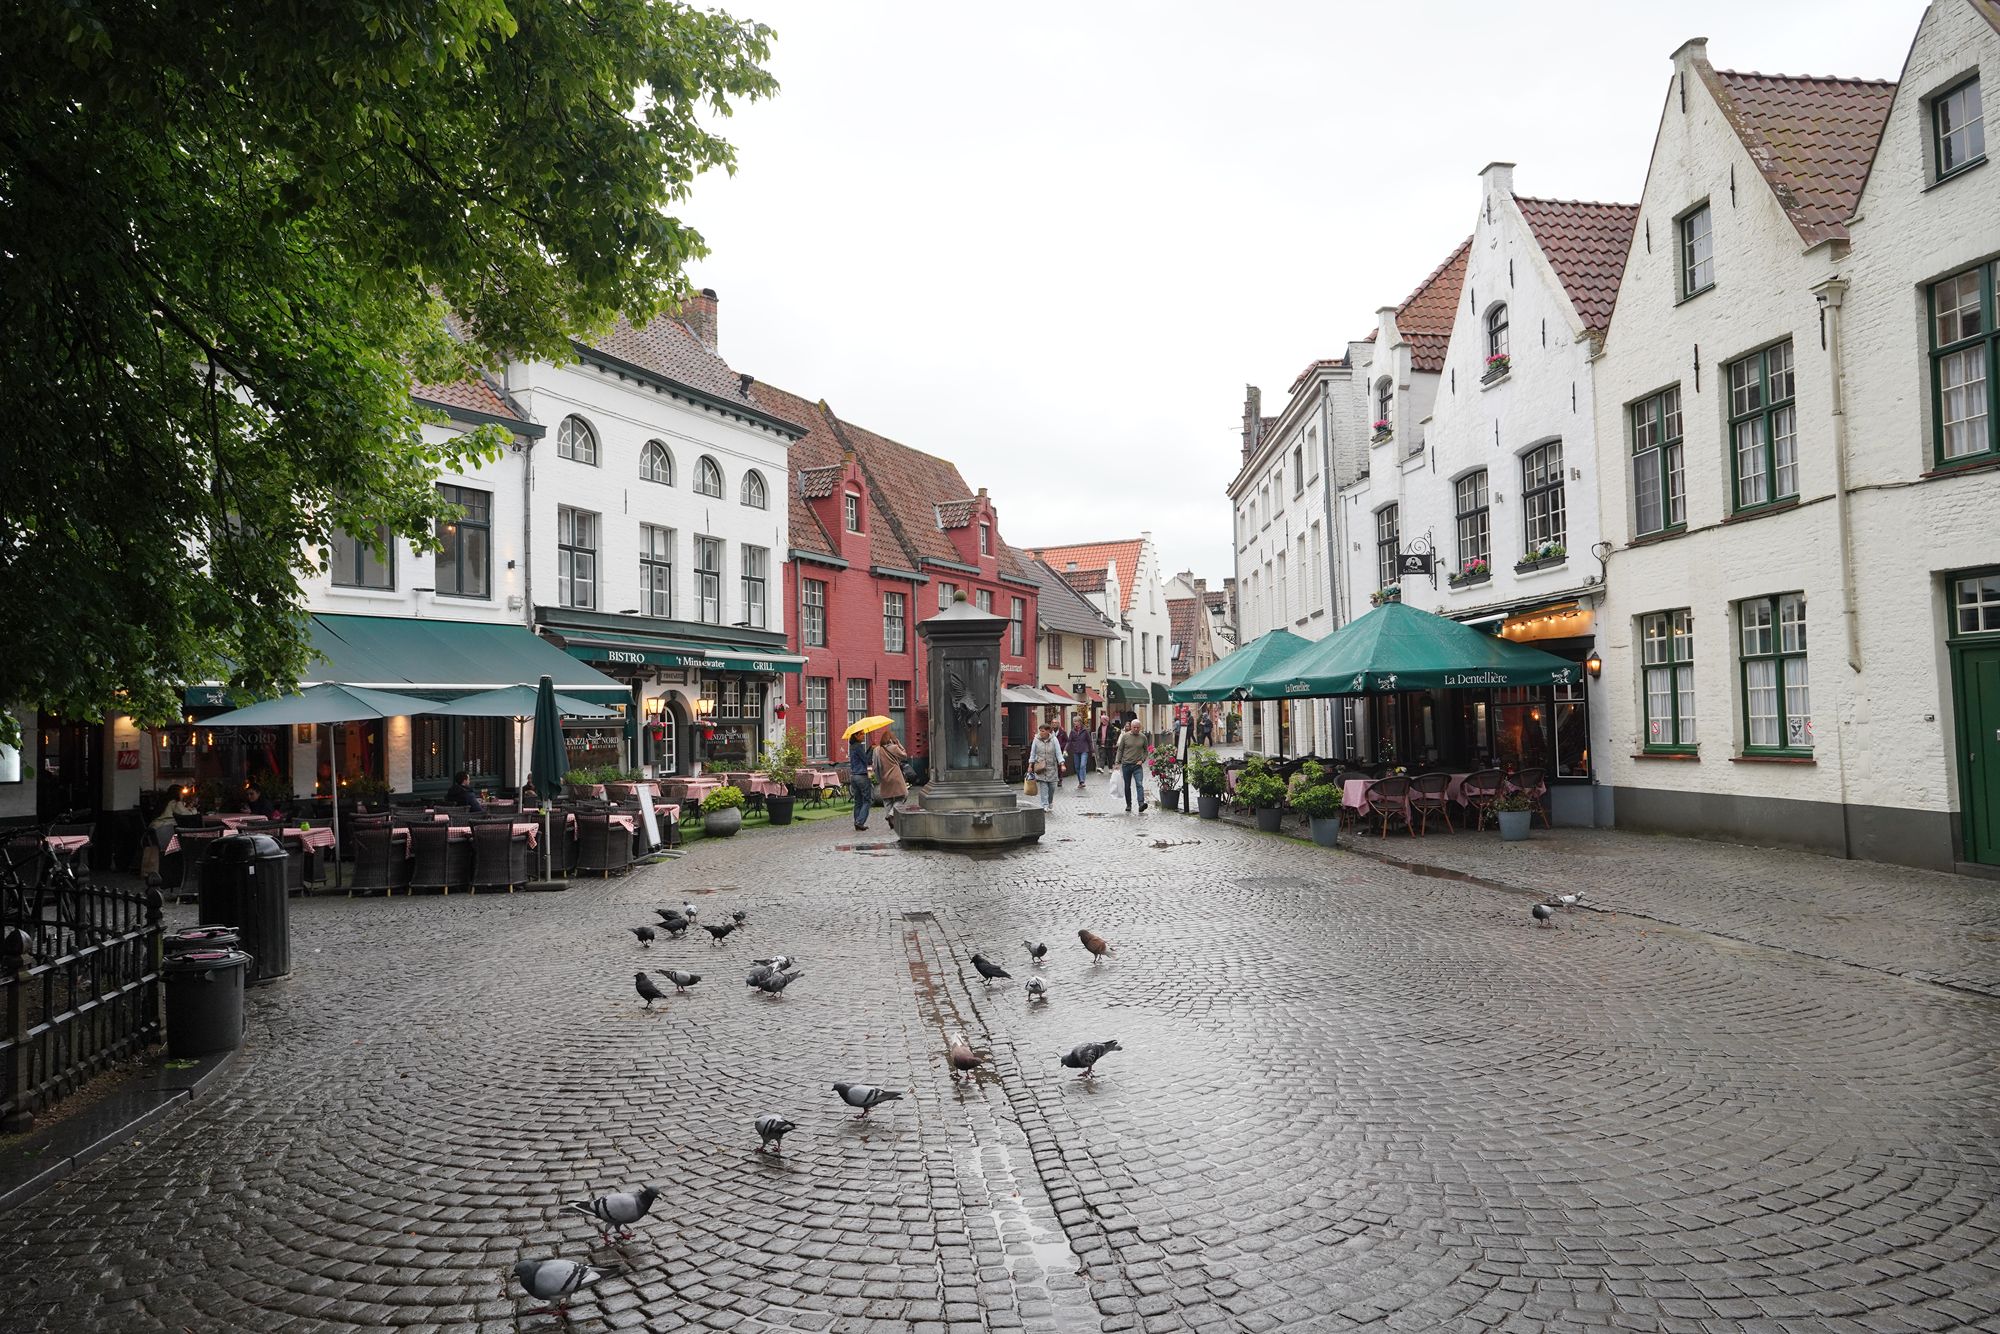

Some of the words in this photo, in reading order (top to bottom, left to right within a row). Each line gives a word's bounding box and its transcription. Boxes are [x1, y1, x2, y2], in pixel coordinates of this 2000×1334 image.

[608, 650, 645, 663] BISTRO
[753, 661, 774, 671] GRILL
[1444, 675, 1455, 685] La
[1458, 671, 1508, 684] Dentellière
